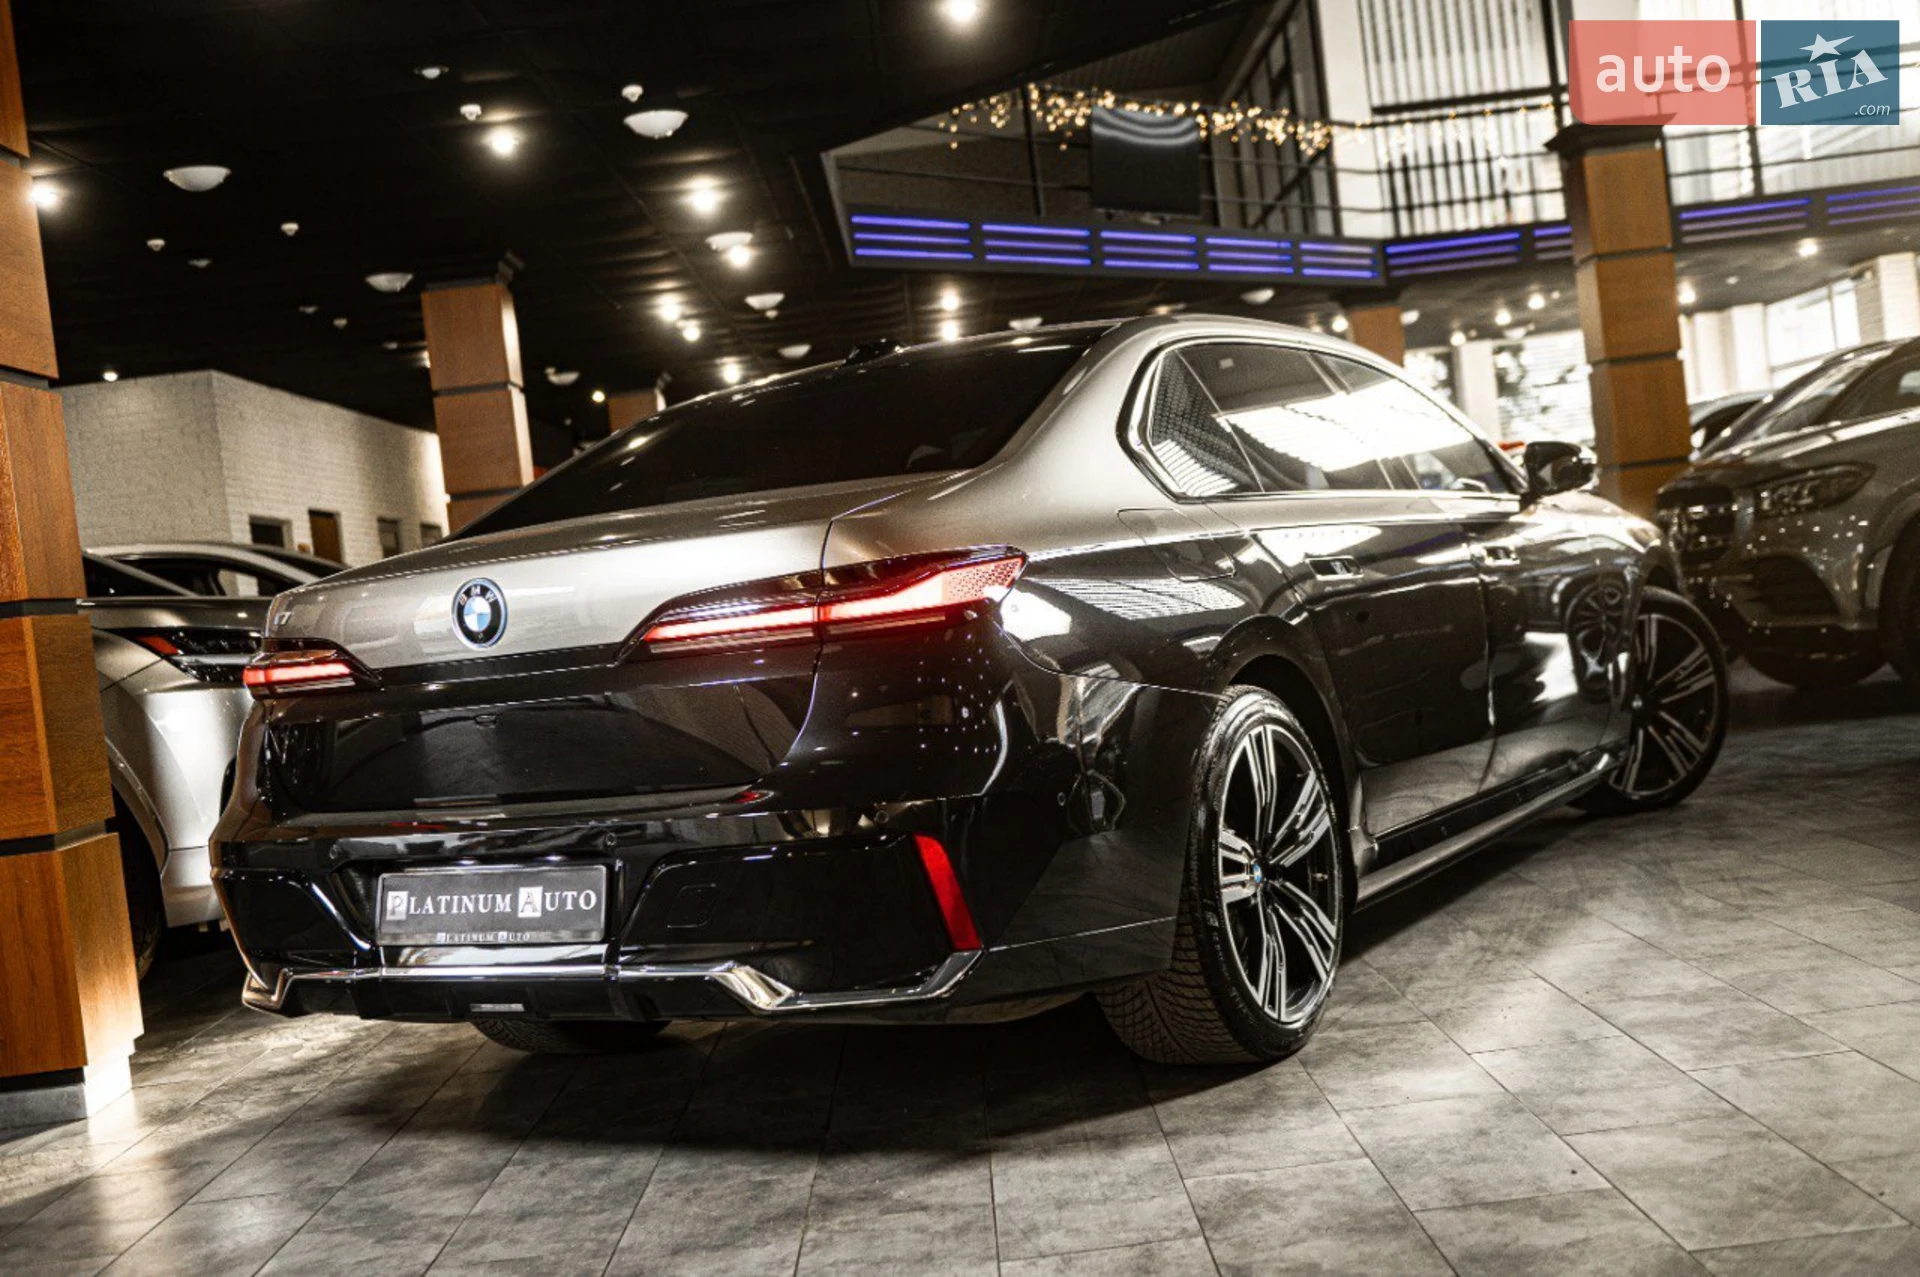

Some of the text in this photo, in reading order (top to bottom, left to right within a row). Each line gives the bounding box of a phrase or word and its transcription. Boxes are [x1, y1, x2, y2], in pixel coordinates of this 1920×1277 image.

[458, 585, 498, 606] BMW
[386, 886, 597, 921] PLATINUM AUTO
